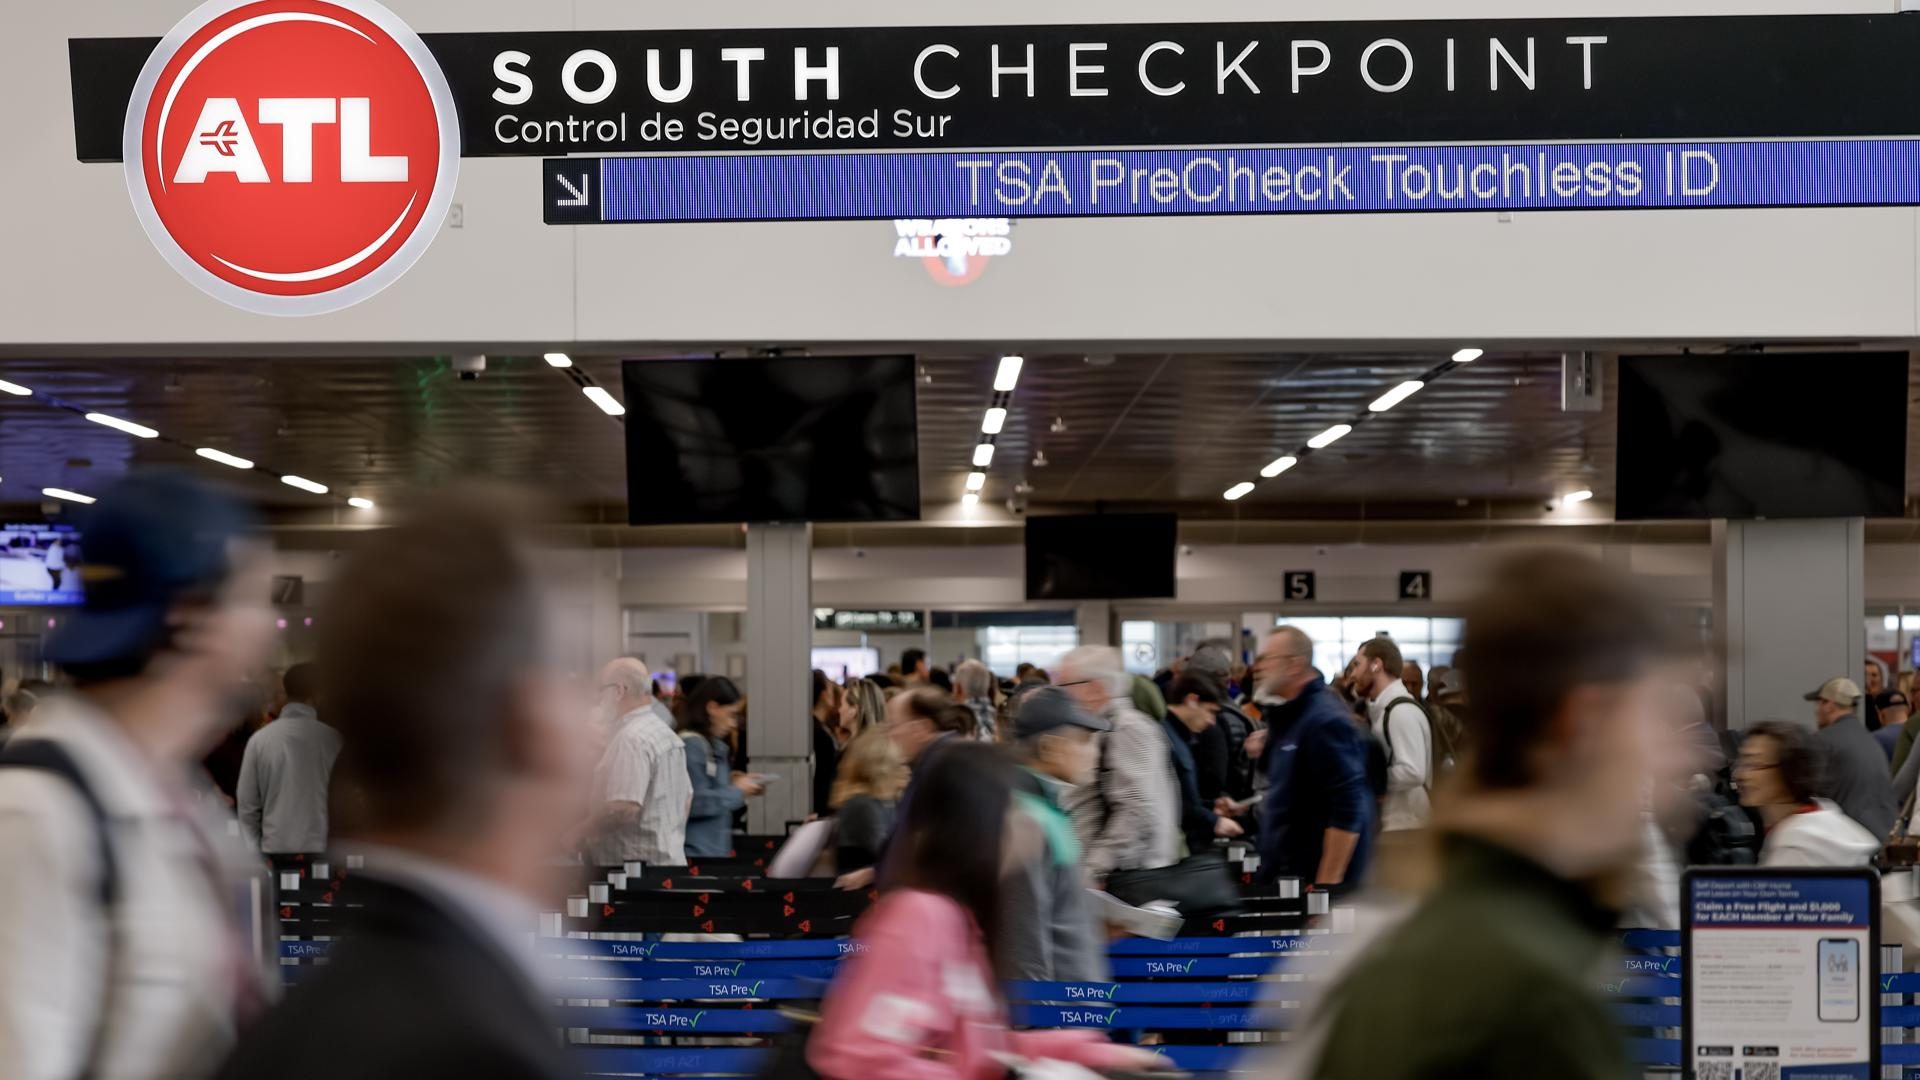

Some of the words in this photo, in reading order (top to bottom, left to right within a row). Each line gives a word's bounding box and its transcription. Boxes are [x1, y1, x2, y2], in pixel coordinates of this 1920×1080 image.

[492, 46, 840, 104] SOUTH
[913, 36, 1608, 100] CHECKPOINT
[494, 112, 626, 144] Control
[640, 111, 684, 142] de
[697, 109, 879, 145] Seguridad
[893, 108, 952, 138] Sur
[173, 97, 409, 184] ATL
[956, 159, 1072, 206] TSA
[1090, 155, 1355, 205] PreCheck
[1371, 152, 1643, 200] Touchless
[1666, 150, 1719, 197] ID
[1291, 574, 1309, 599] 5
[1405, 574, 1425, 598] 4
[288, 945, 304, 954] TSA
[612, 944, 629, 955] TSA
[630, 945, 645, 955] Pre
[838, 943, 854, 953] TSA
[1271, 939, 1288, 949] TSA
[694, 965, 712, 976] TSA
[714, 966, 730, 976] Pre
[1146, 962, 1165, 973] TSA
[1166, 962, 1183, 973] Pre
[1625, 960, 1642, 969] TSA
[1644, 960, 1661, 970] Pre
[709, 984, 729, 996] TSA
[731, 985, 748, 996] Pre
[1065, 987, 1085, 998] TSA
[1087, 987, 1104, 998] Pre
[645, 1013, 667, 1025] TSA
[669, 1014, 688, 1026] Pre
[1060, 1011, 1082, 1023] TSA
[1084, 1012, 1103, 1023] Pre
